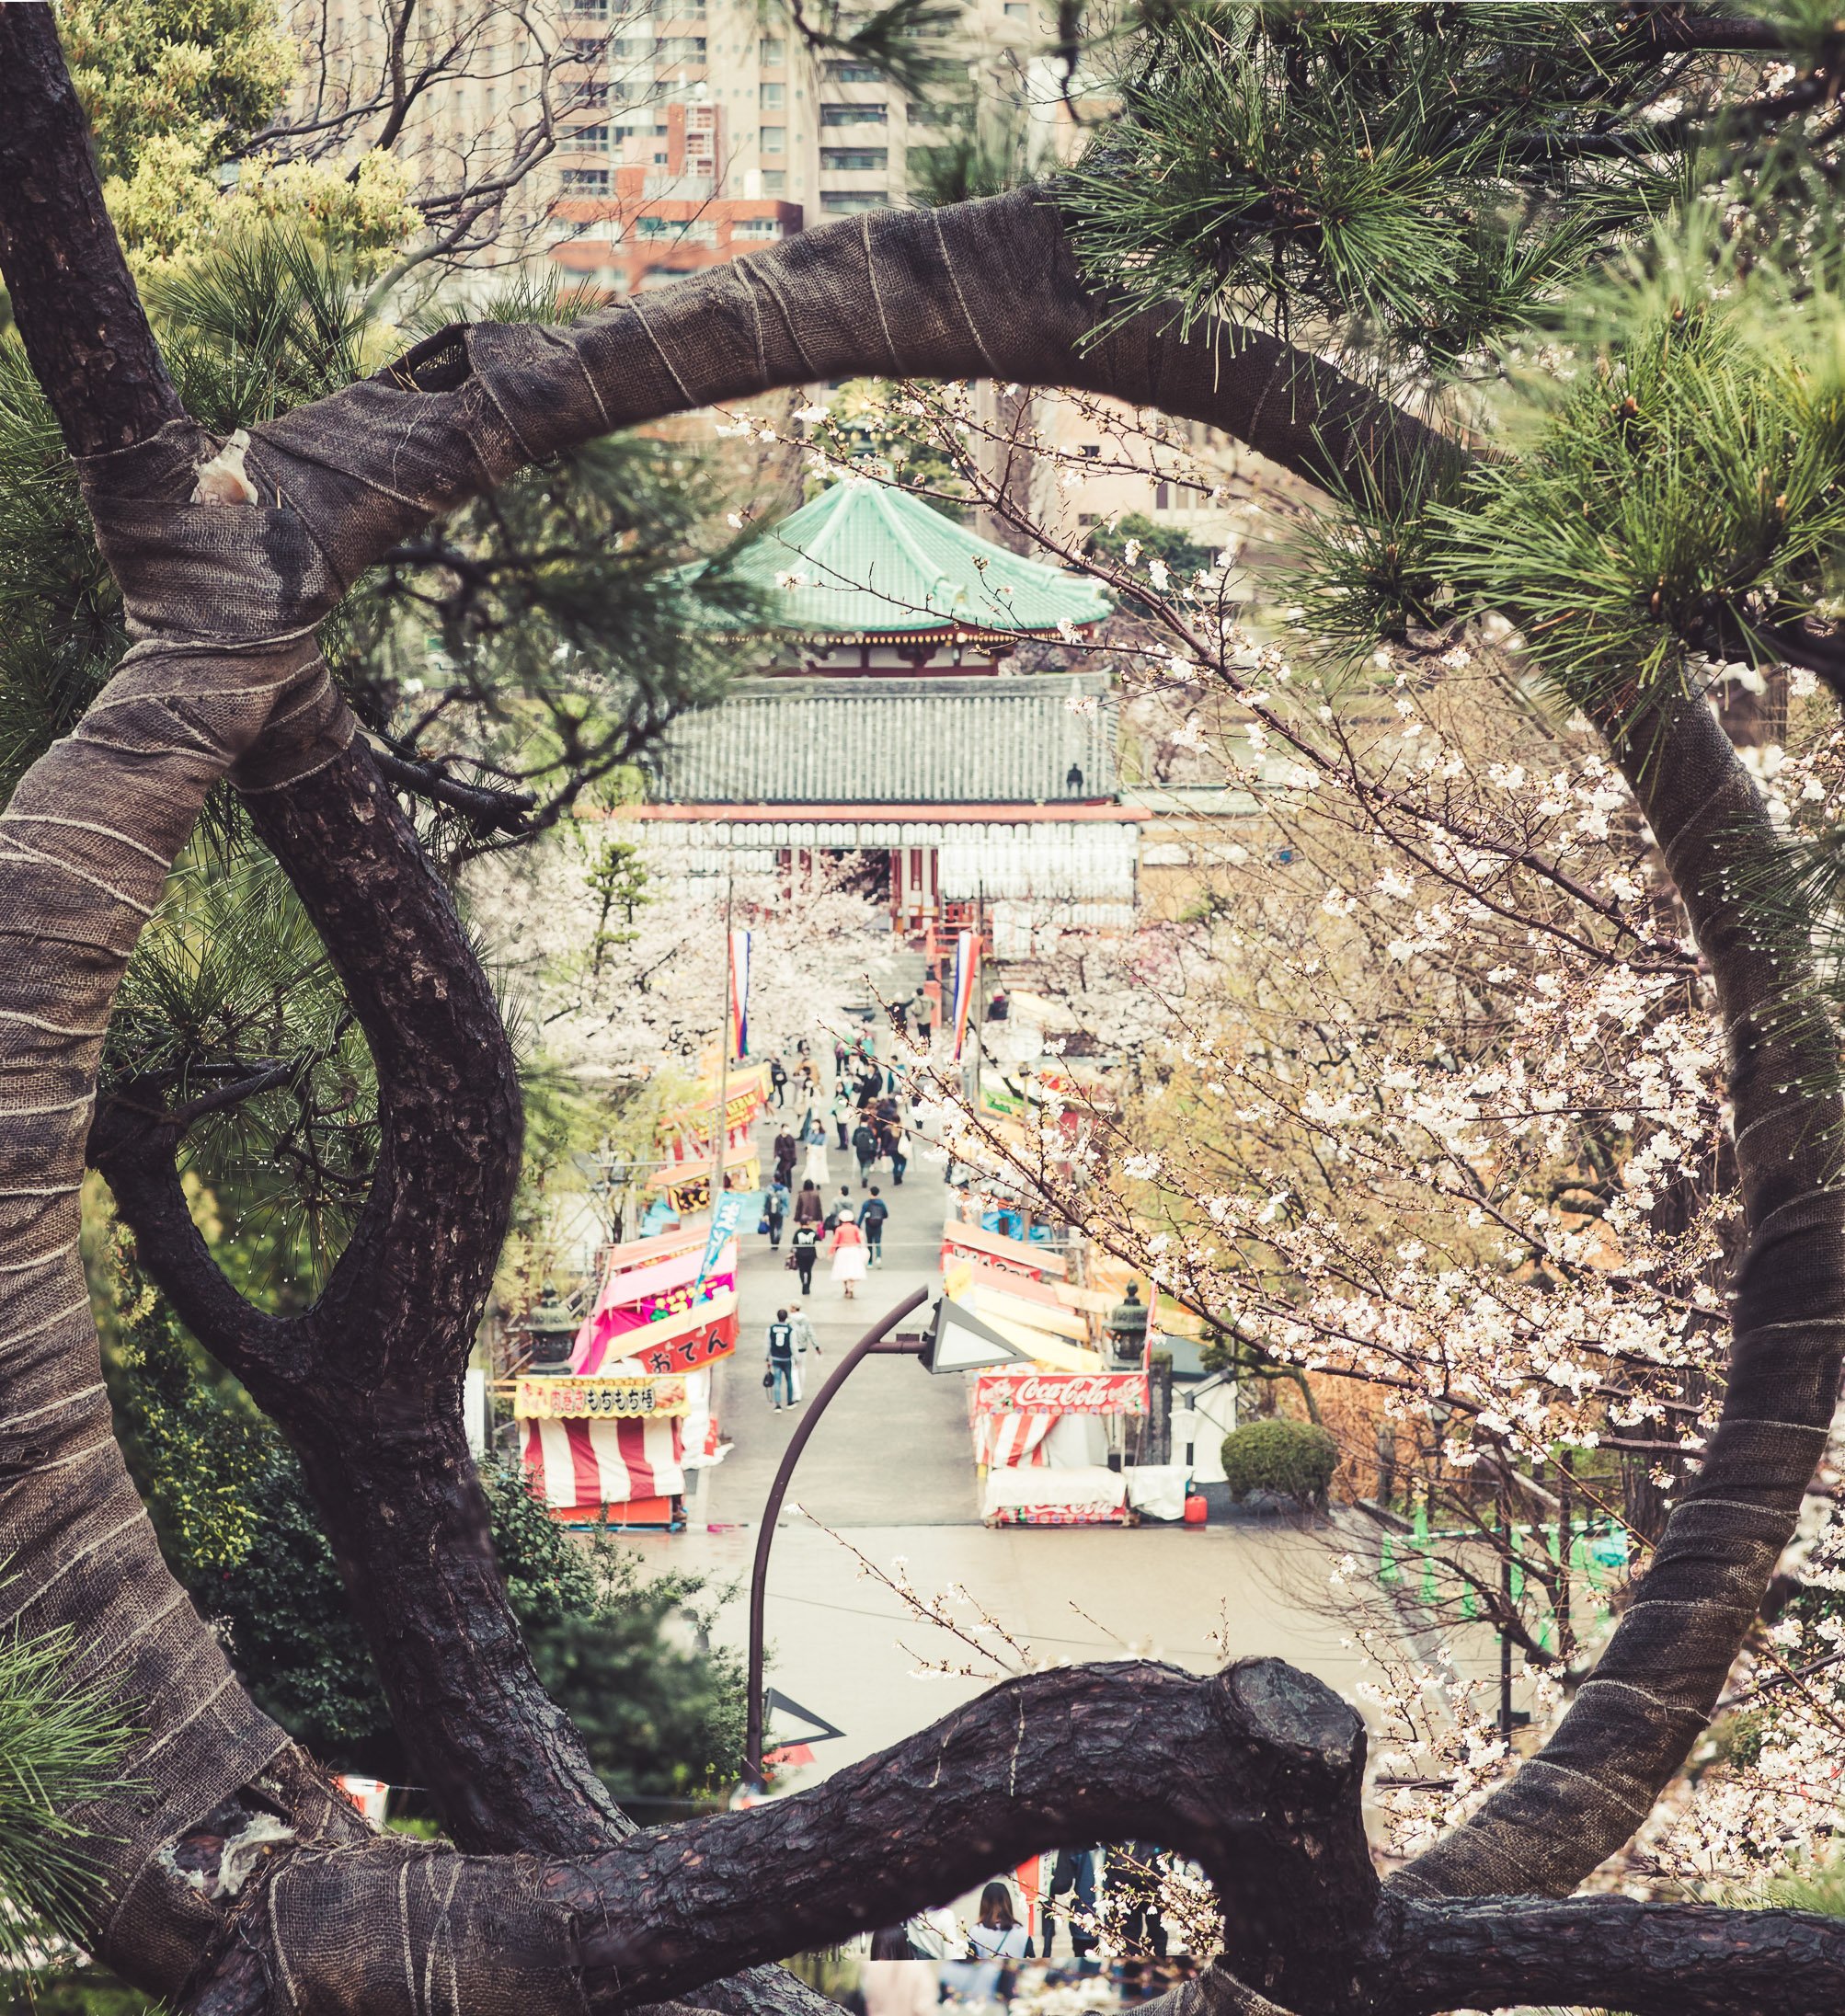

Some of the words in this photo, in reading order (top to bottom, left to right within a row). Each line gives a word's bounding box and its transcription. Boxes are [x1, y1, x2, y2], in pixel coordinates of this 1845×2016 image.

[649, 1329, 728, 1373] おでん
[1015, 1377, 1111, 1406] Coca-Cola
